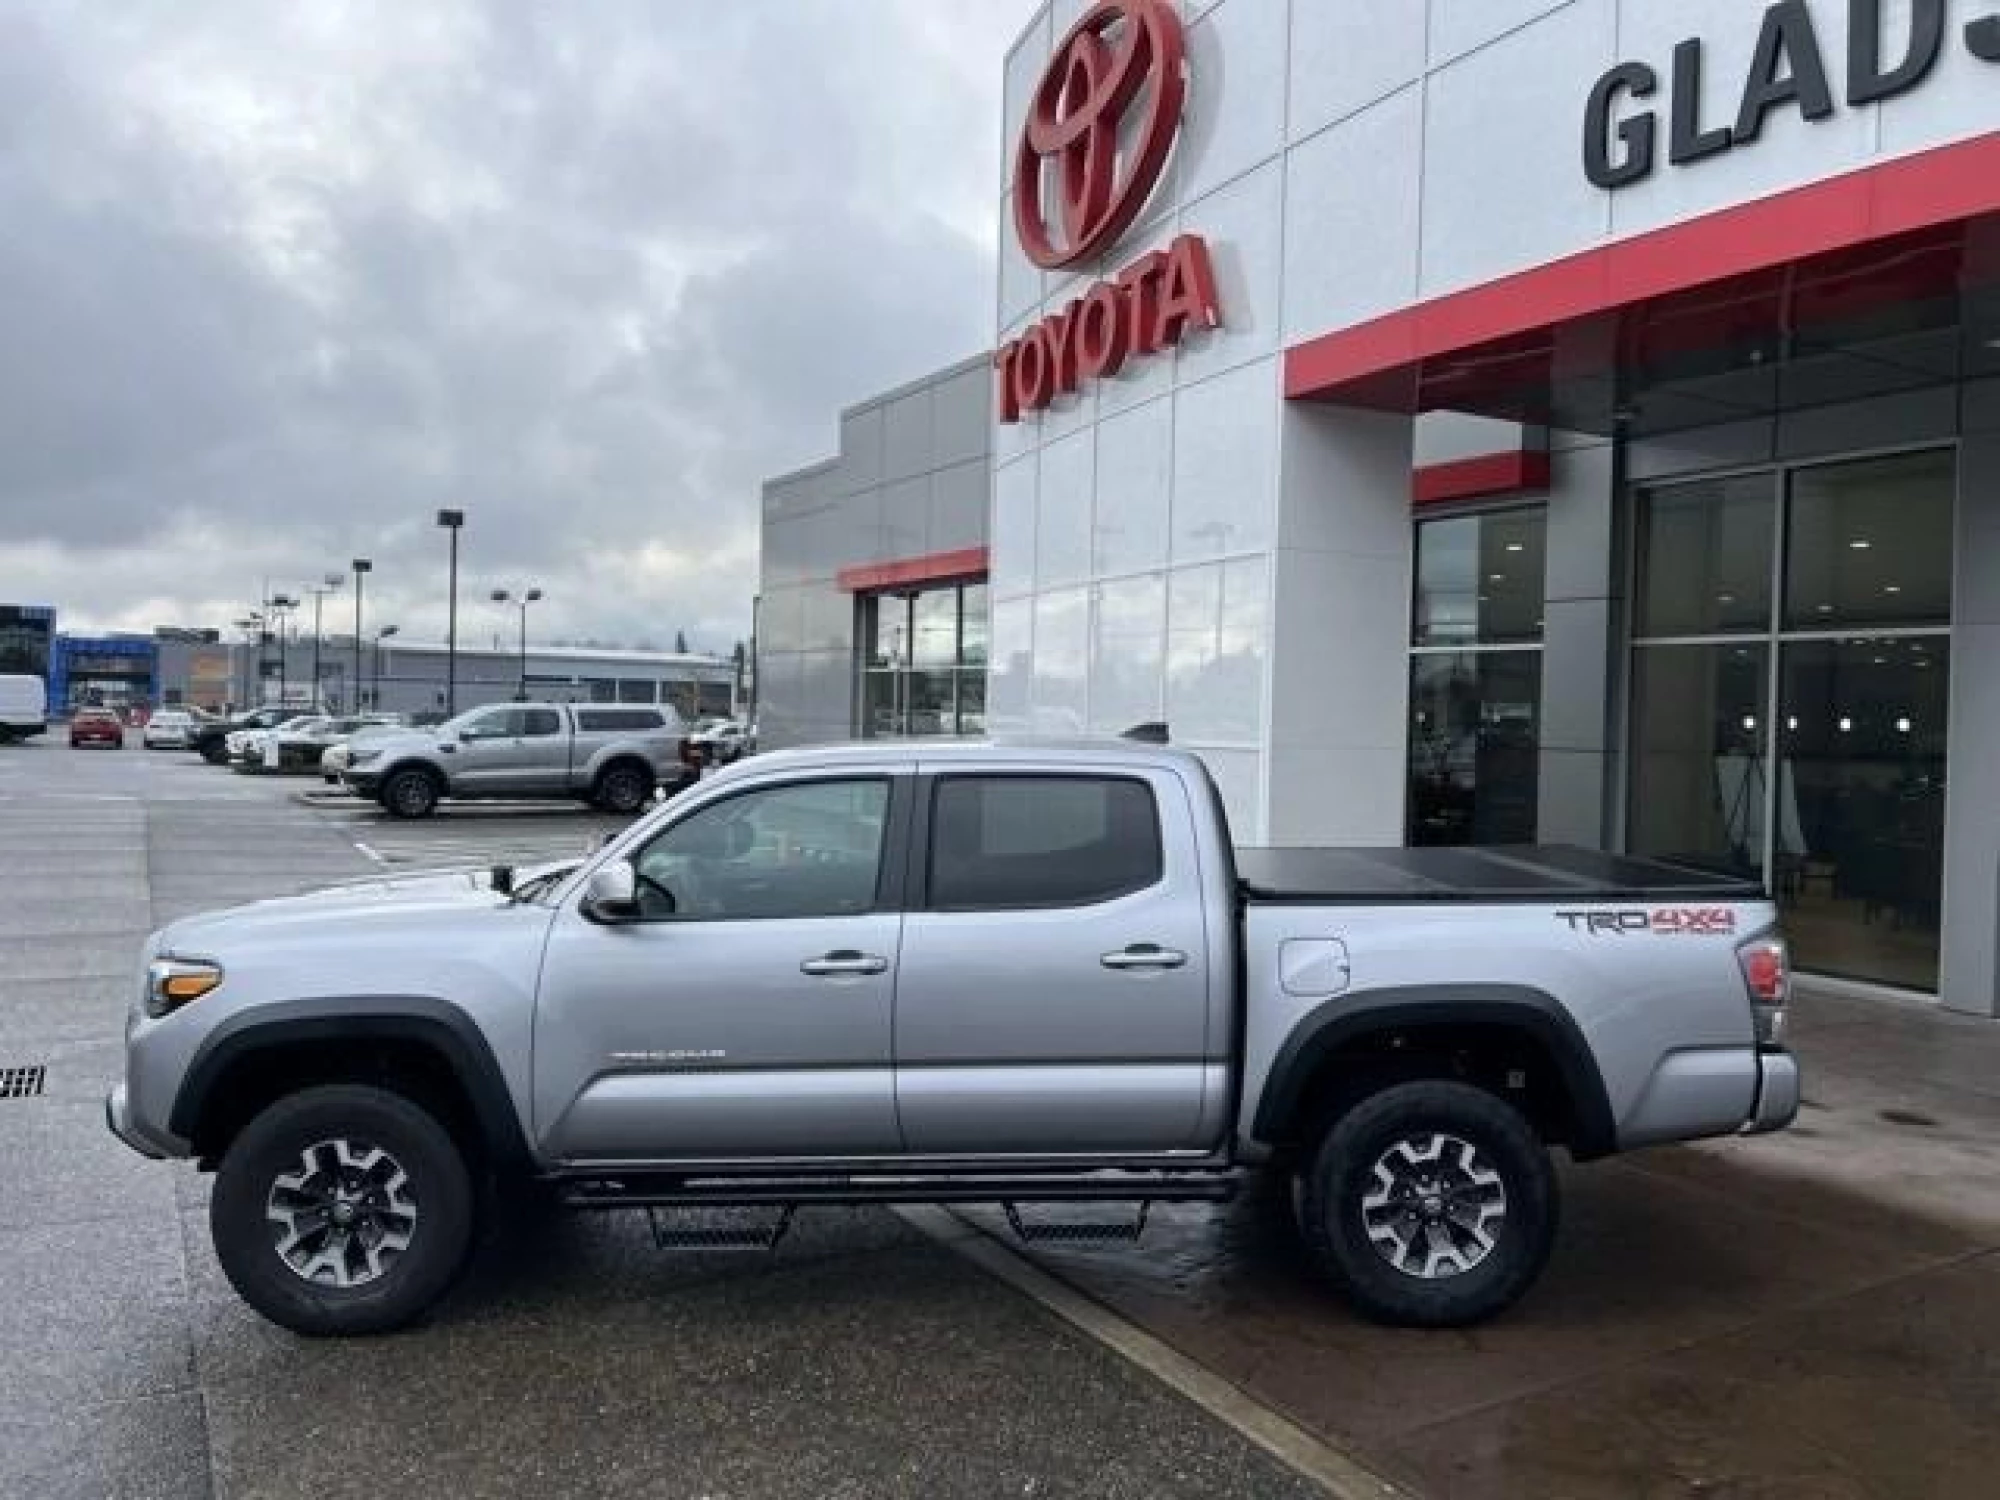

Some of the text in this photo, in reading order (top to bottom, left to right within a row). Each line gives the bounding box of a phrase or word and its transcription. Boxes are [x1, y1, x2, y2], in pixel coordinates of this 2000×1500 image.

[1584, 0, 2000, 189] GLAD
[994, 234, 1224, 422] TOYOTA
[1555, 911, 1648, 935] TRD
